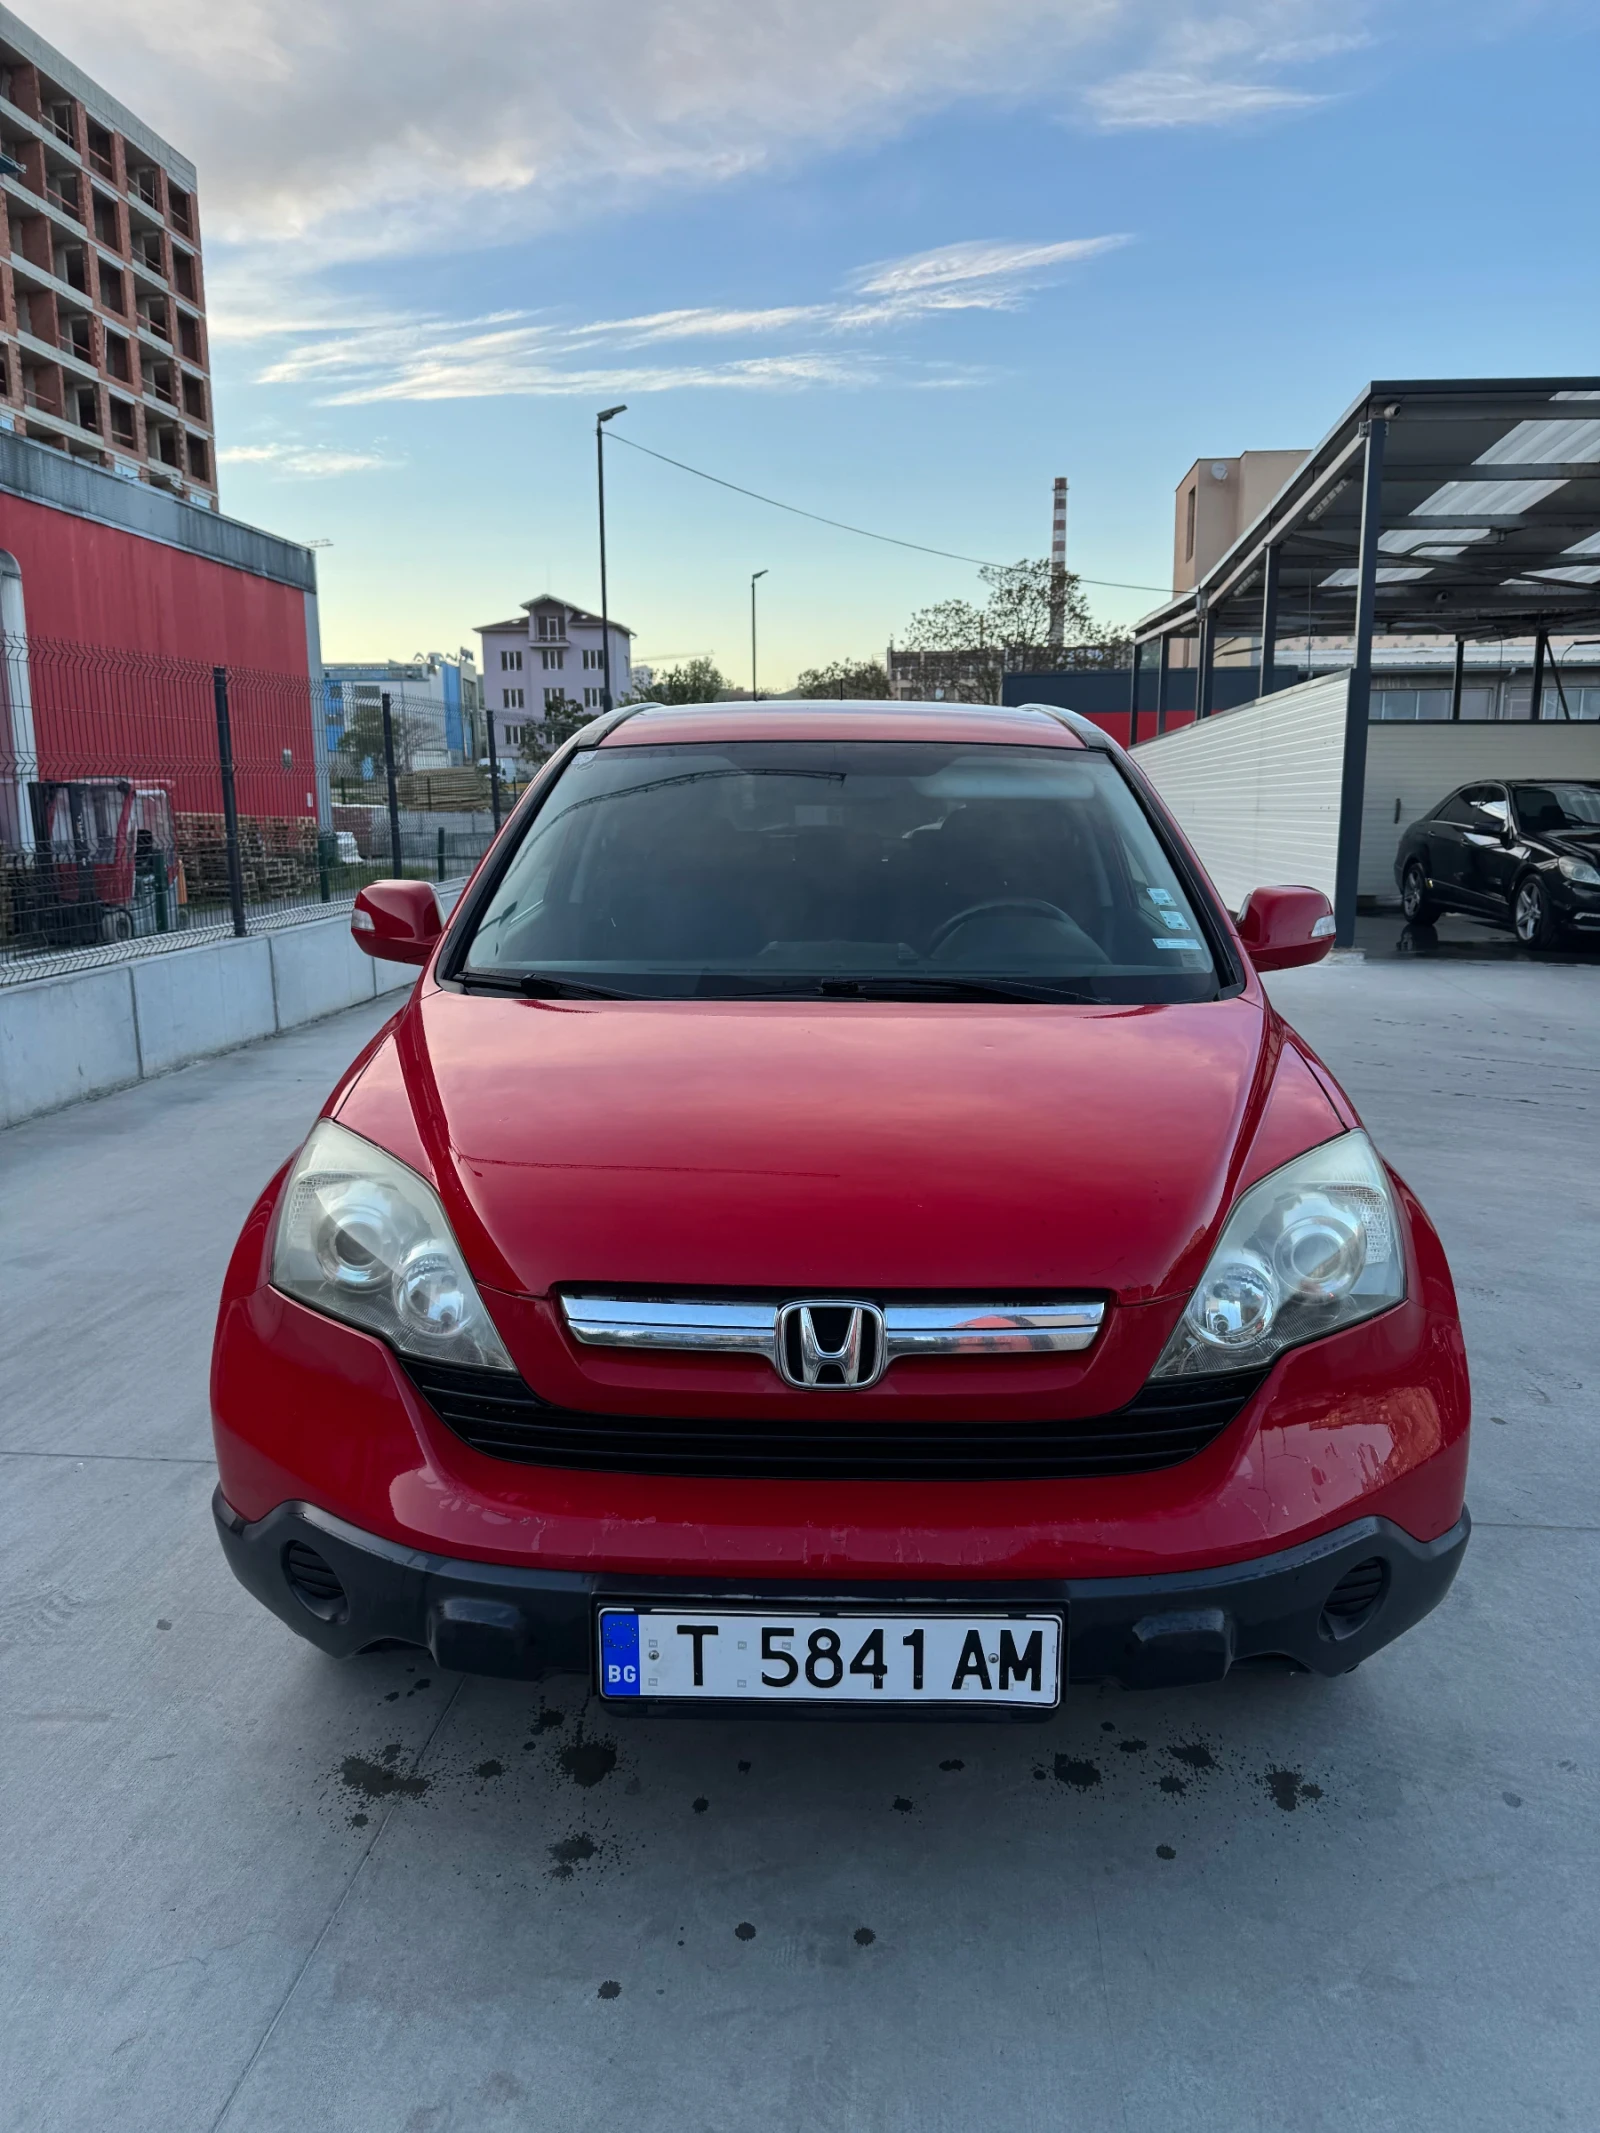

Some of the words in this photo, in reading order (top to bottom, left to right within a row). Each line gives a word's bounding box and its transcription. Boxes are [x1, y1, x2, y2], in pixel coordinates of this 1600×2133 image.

[608, 1664, 637, 1683] BG
[676, 1624, 719, 1687] T
[761, 1627, 924, 1689] 5841
[951, 1629, 1043, 1691] AM
